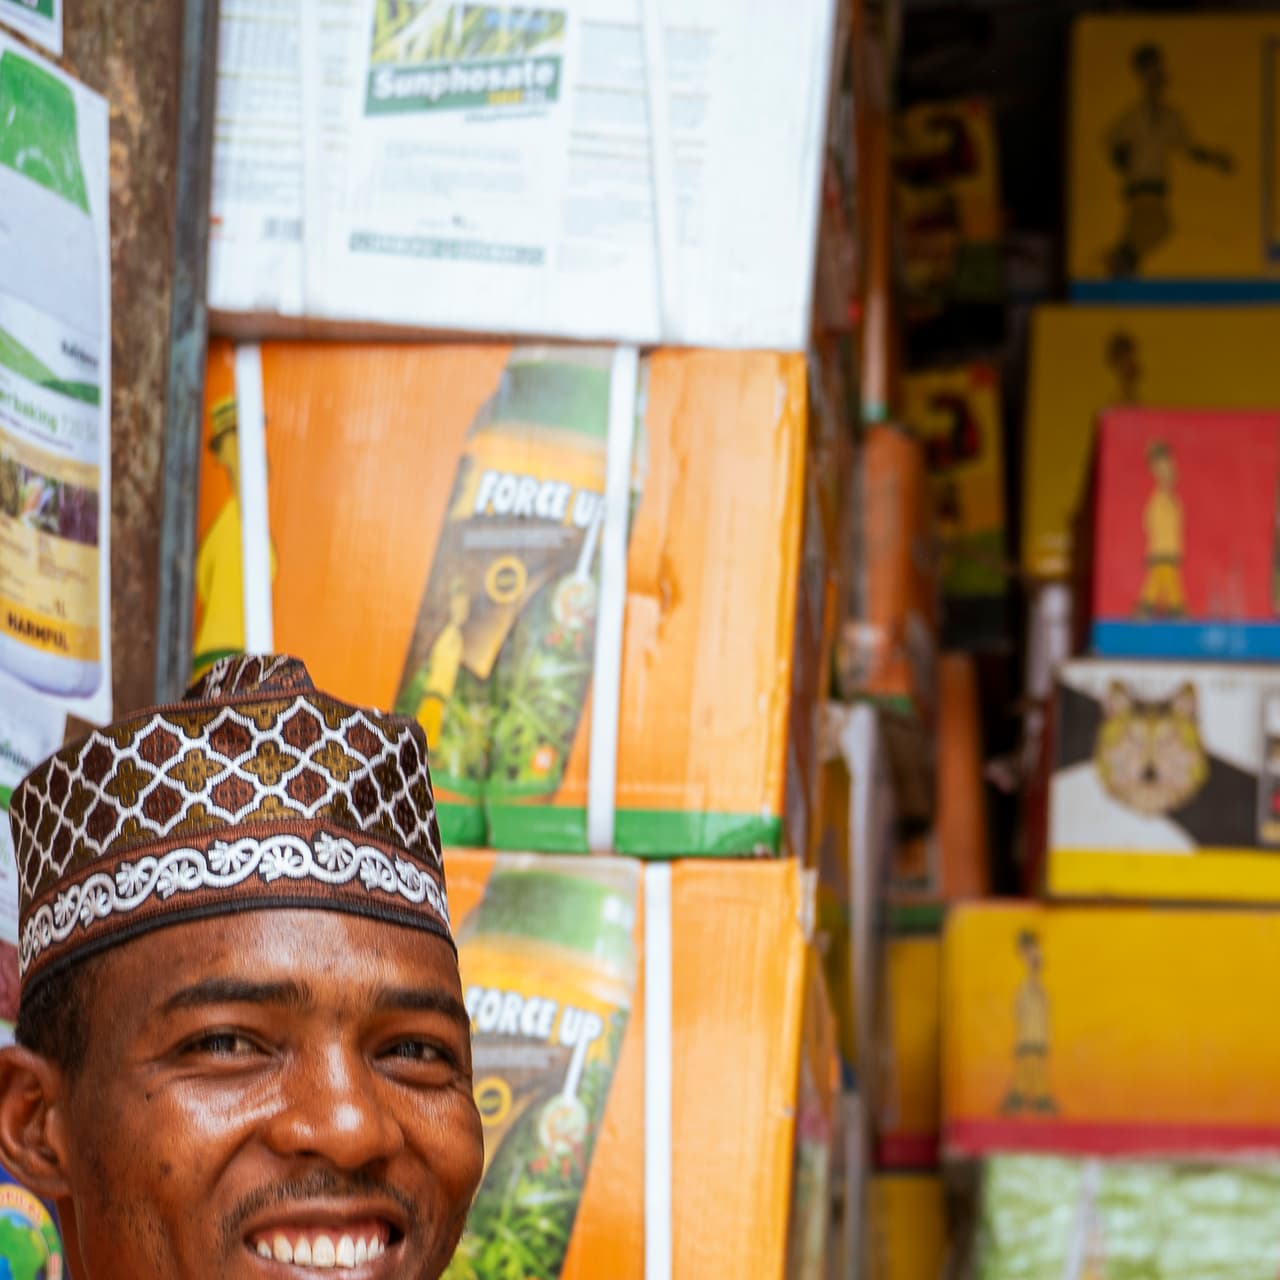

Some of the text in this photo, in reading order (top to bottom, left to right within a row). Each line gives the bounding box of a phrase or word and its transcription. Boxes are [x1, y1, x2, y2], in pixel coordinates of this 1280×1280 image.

[374, 58, 555, 101] Sunphosate
[475, 469, 569, 518] FORCE
[8, 611, 70, 651] HARMFUL
[466, 986, 603, 1048] FORCE UP
